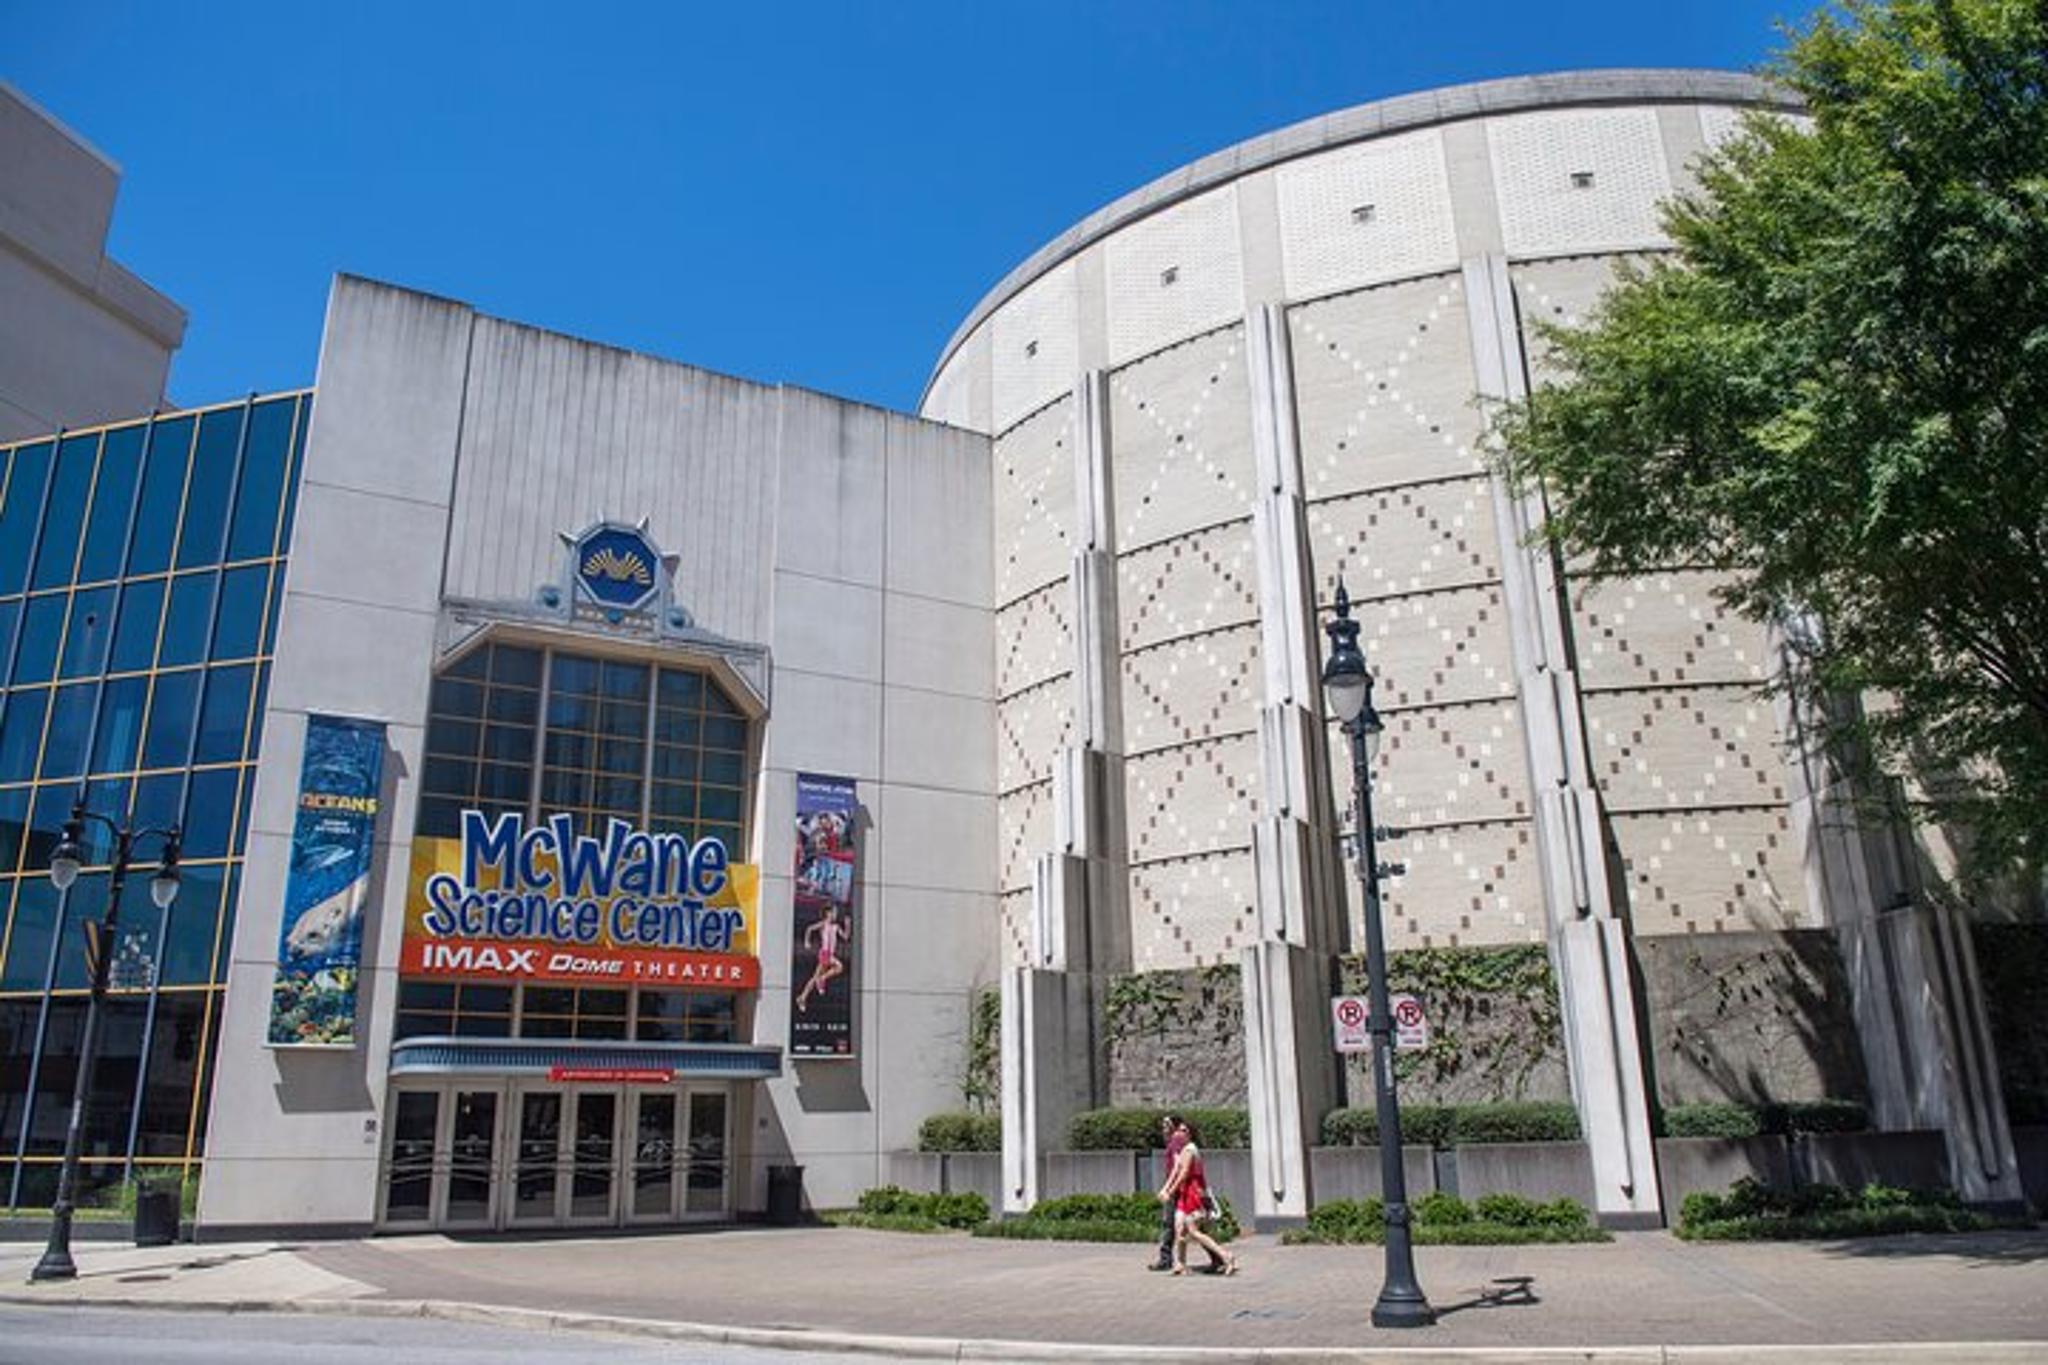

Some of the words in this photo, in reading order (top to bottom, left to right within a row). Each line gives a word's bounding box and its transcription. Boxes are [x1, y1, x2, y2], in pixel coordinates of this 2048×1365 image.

[460, 809, 730, 899] McWane
[423, 872, 602, 943] Science
[422, 943, 536, 973] IMAX
[633, 960, 743, 980] THEATER
